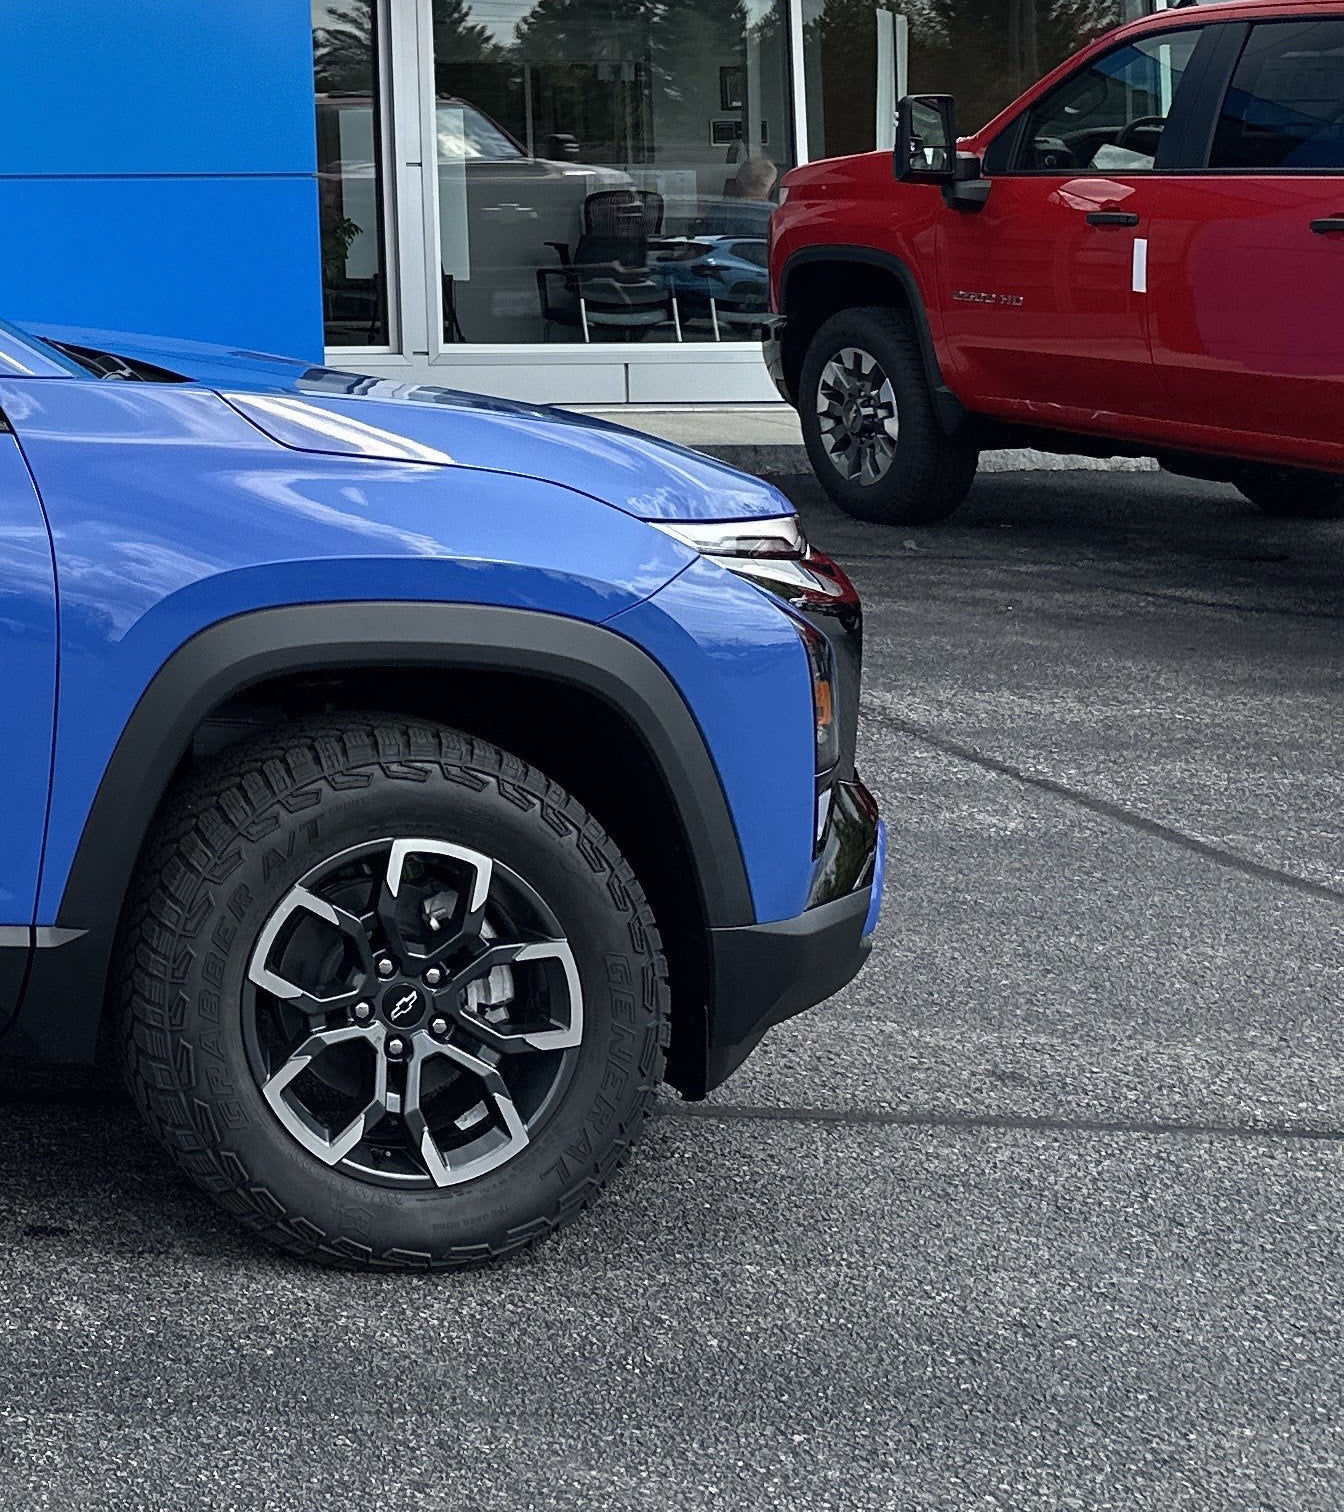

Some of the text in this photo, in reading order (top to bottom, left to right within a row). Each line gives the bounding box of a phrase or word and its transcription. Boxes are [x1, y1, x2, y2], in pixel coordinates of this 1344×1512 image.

[198, 817, 324, 1130] GRABBER A/T
[539, 953, 637, 1188] GENERAL
